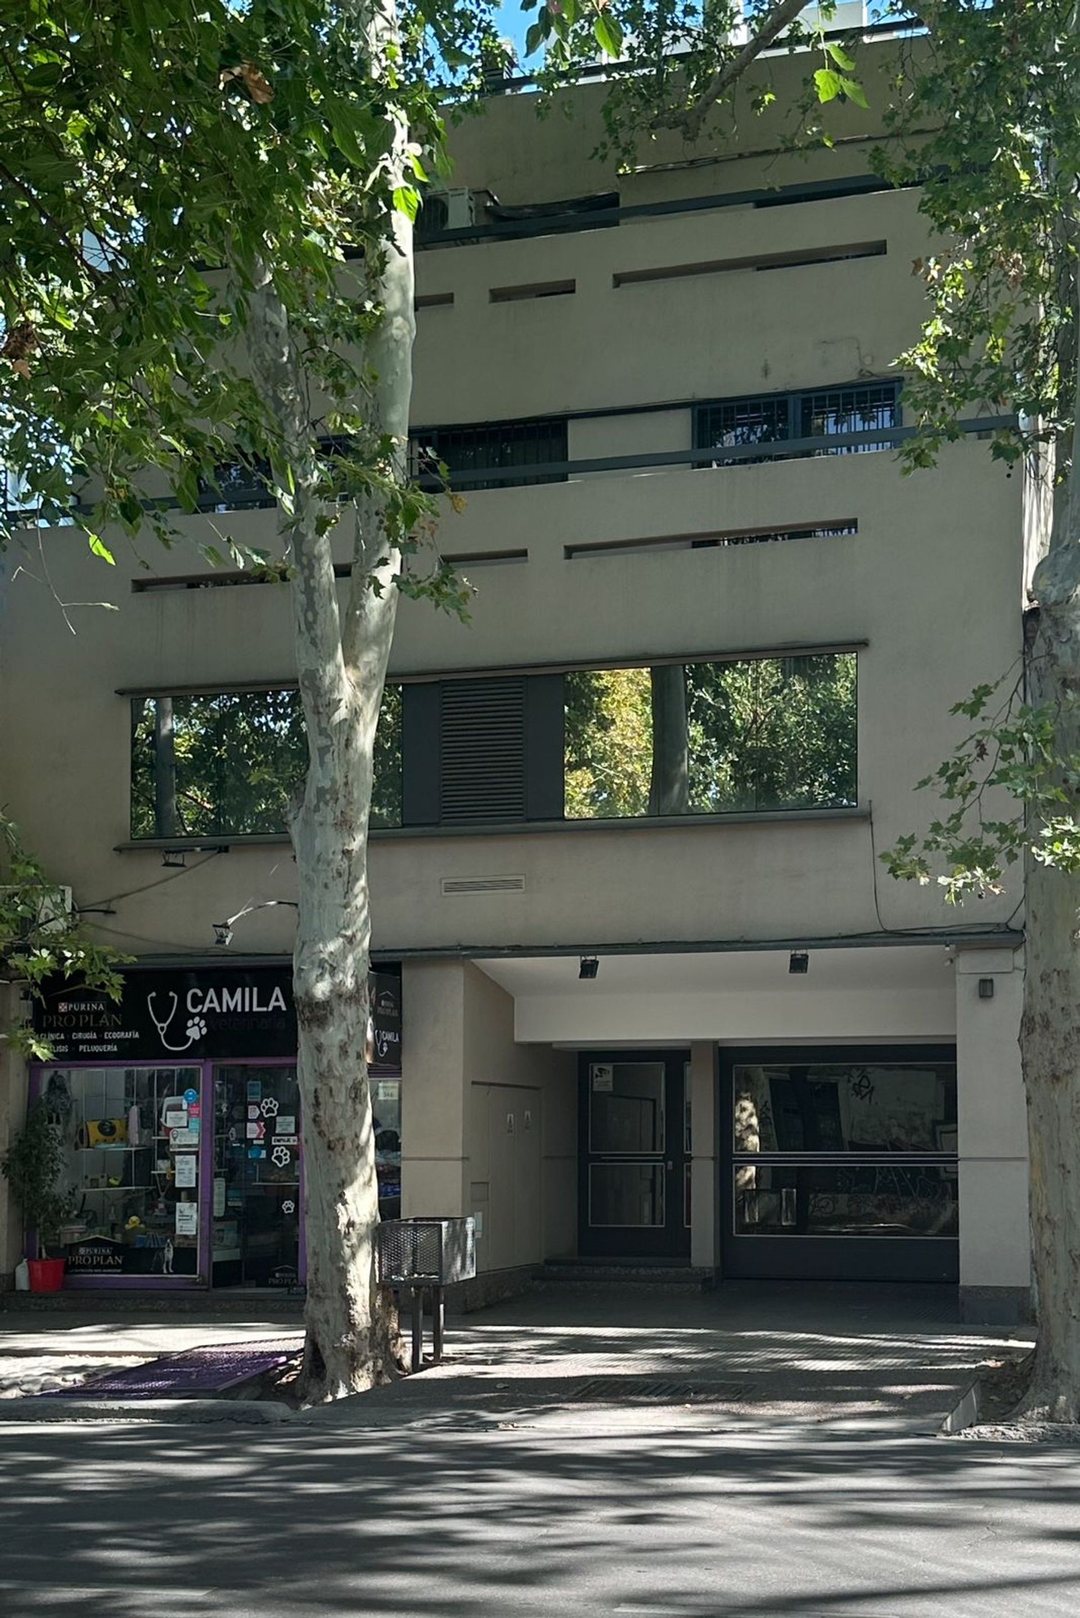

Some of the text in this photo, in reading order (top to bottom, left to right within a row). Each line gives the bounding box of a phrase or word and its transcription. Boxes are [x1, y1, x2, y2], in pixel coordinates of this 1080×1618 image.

[186, 986, 287, 1013] CAMILA
[68, 1003, 104, 1012] PURINA
[43, 1014, 122, 1028] PRO PLAN
[72, 1031, 97, 1040] CIRUGÍA
[104, 1030, 140, 1039] ECOGRAFÍA
[78, 1044, 118, 1053] PELUQUERÍA
[68, 1255, 124, 1265] PRO PLAN
